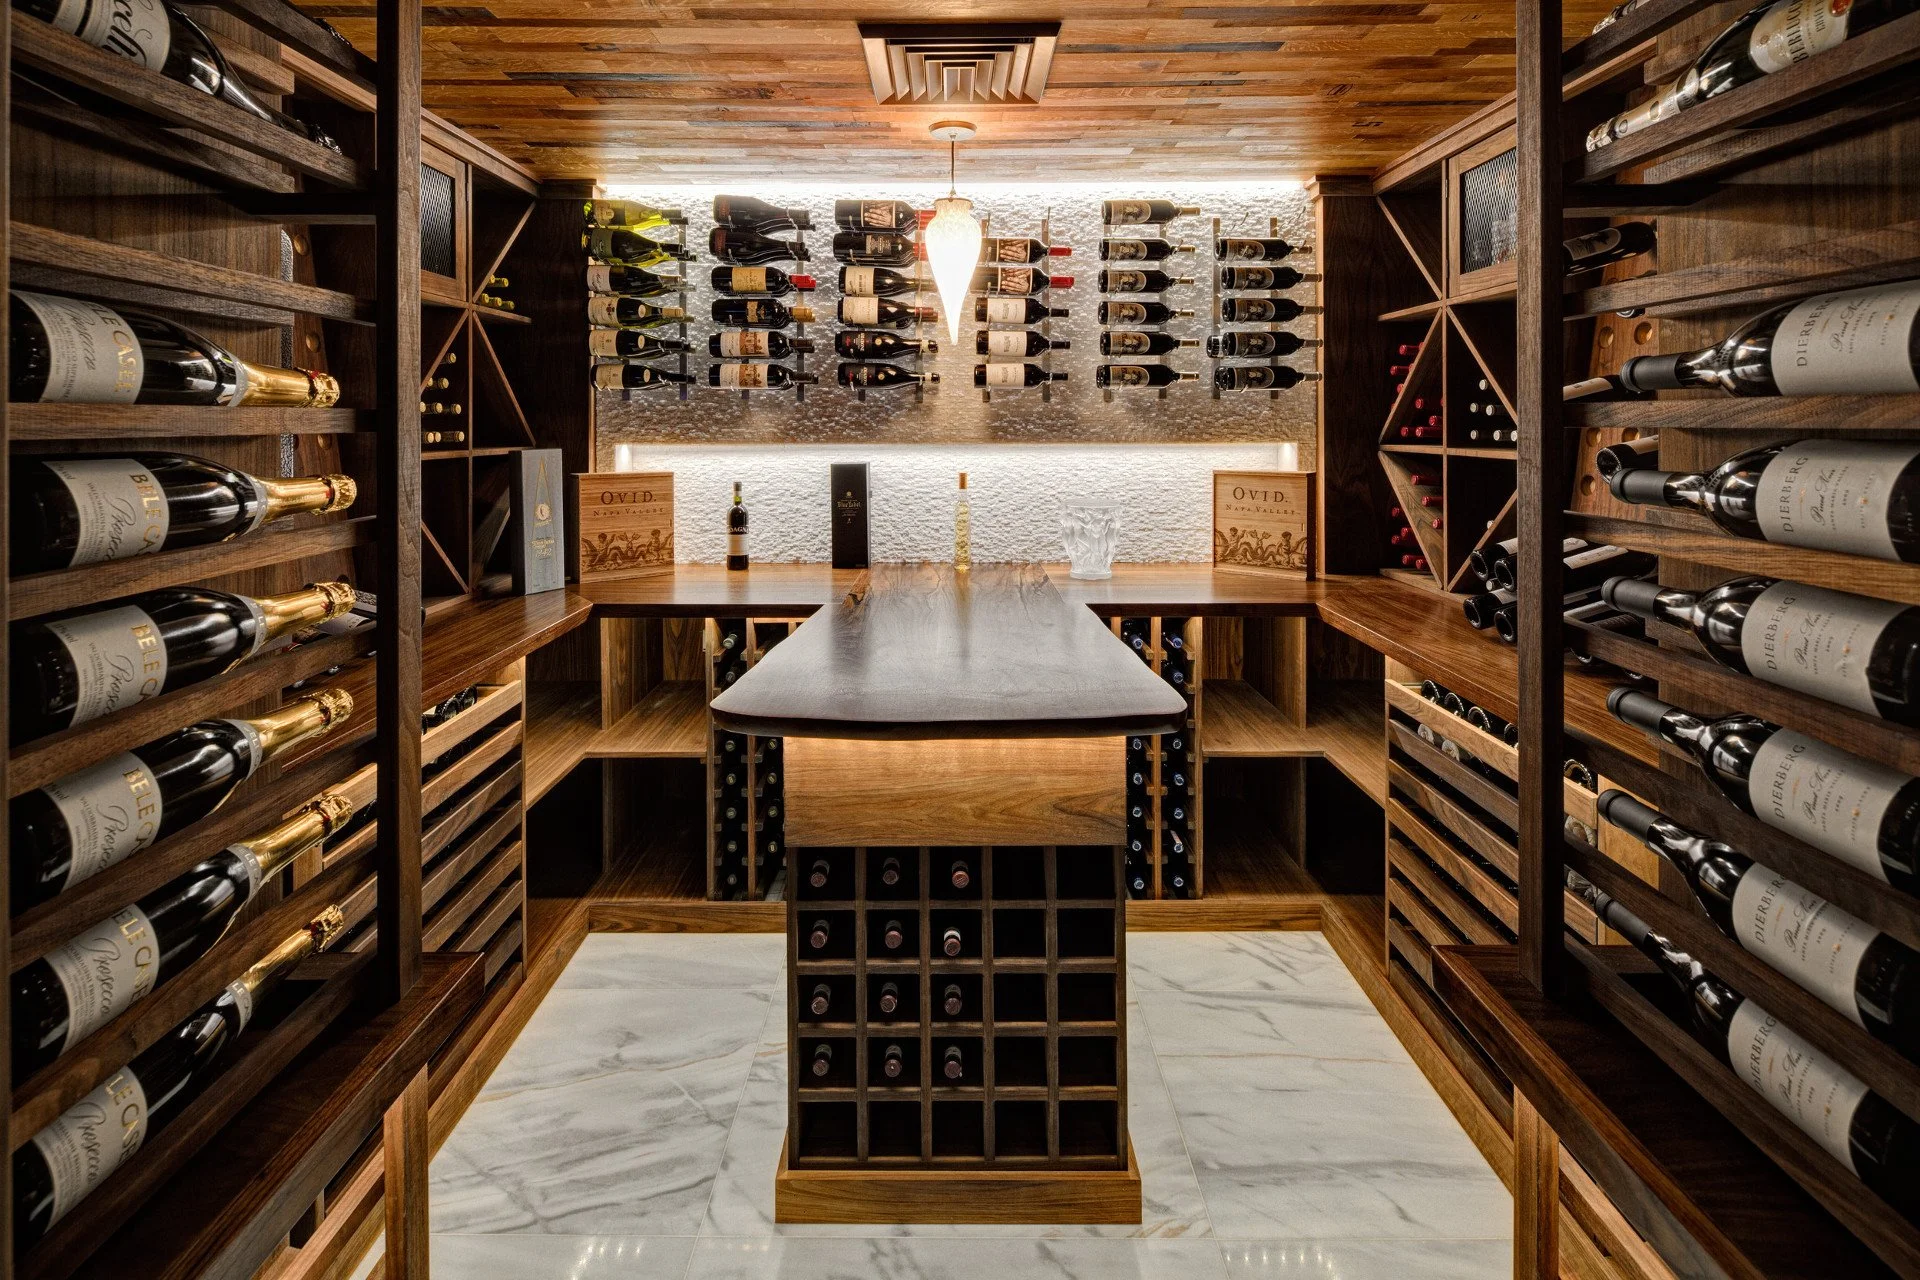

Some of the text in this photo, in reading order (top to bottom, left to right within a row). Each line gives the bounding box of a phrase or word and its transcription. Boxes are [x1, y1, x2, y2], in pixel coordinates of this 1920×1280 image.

[129, 474, 161, 520] BELE
[1780, 456, 1809, 533] DIERBERG
[1810, 494, 1826, 527] Pinot
[131, 624, 160, 674] BELE
[1765, 596, 1796, 671] DIERBERG
[1794, 637, 1809, 669] Pinot
[122, 767, 155, 820] BELE
[1772, 744, 1806, 820] DIERBERG
[1803, 792, 1818, 824] Pinot
[1784, 921, 1801, 953] Pinot
[78, 937, 121, 1015] Prosecco
[66, 1101, 107, 1183] Prosecco
